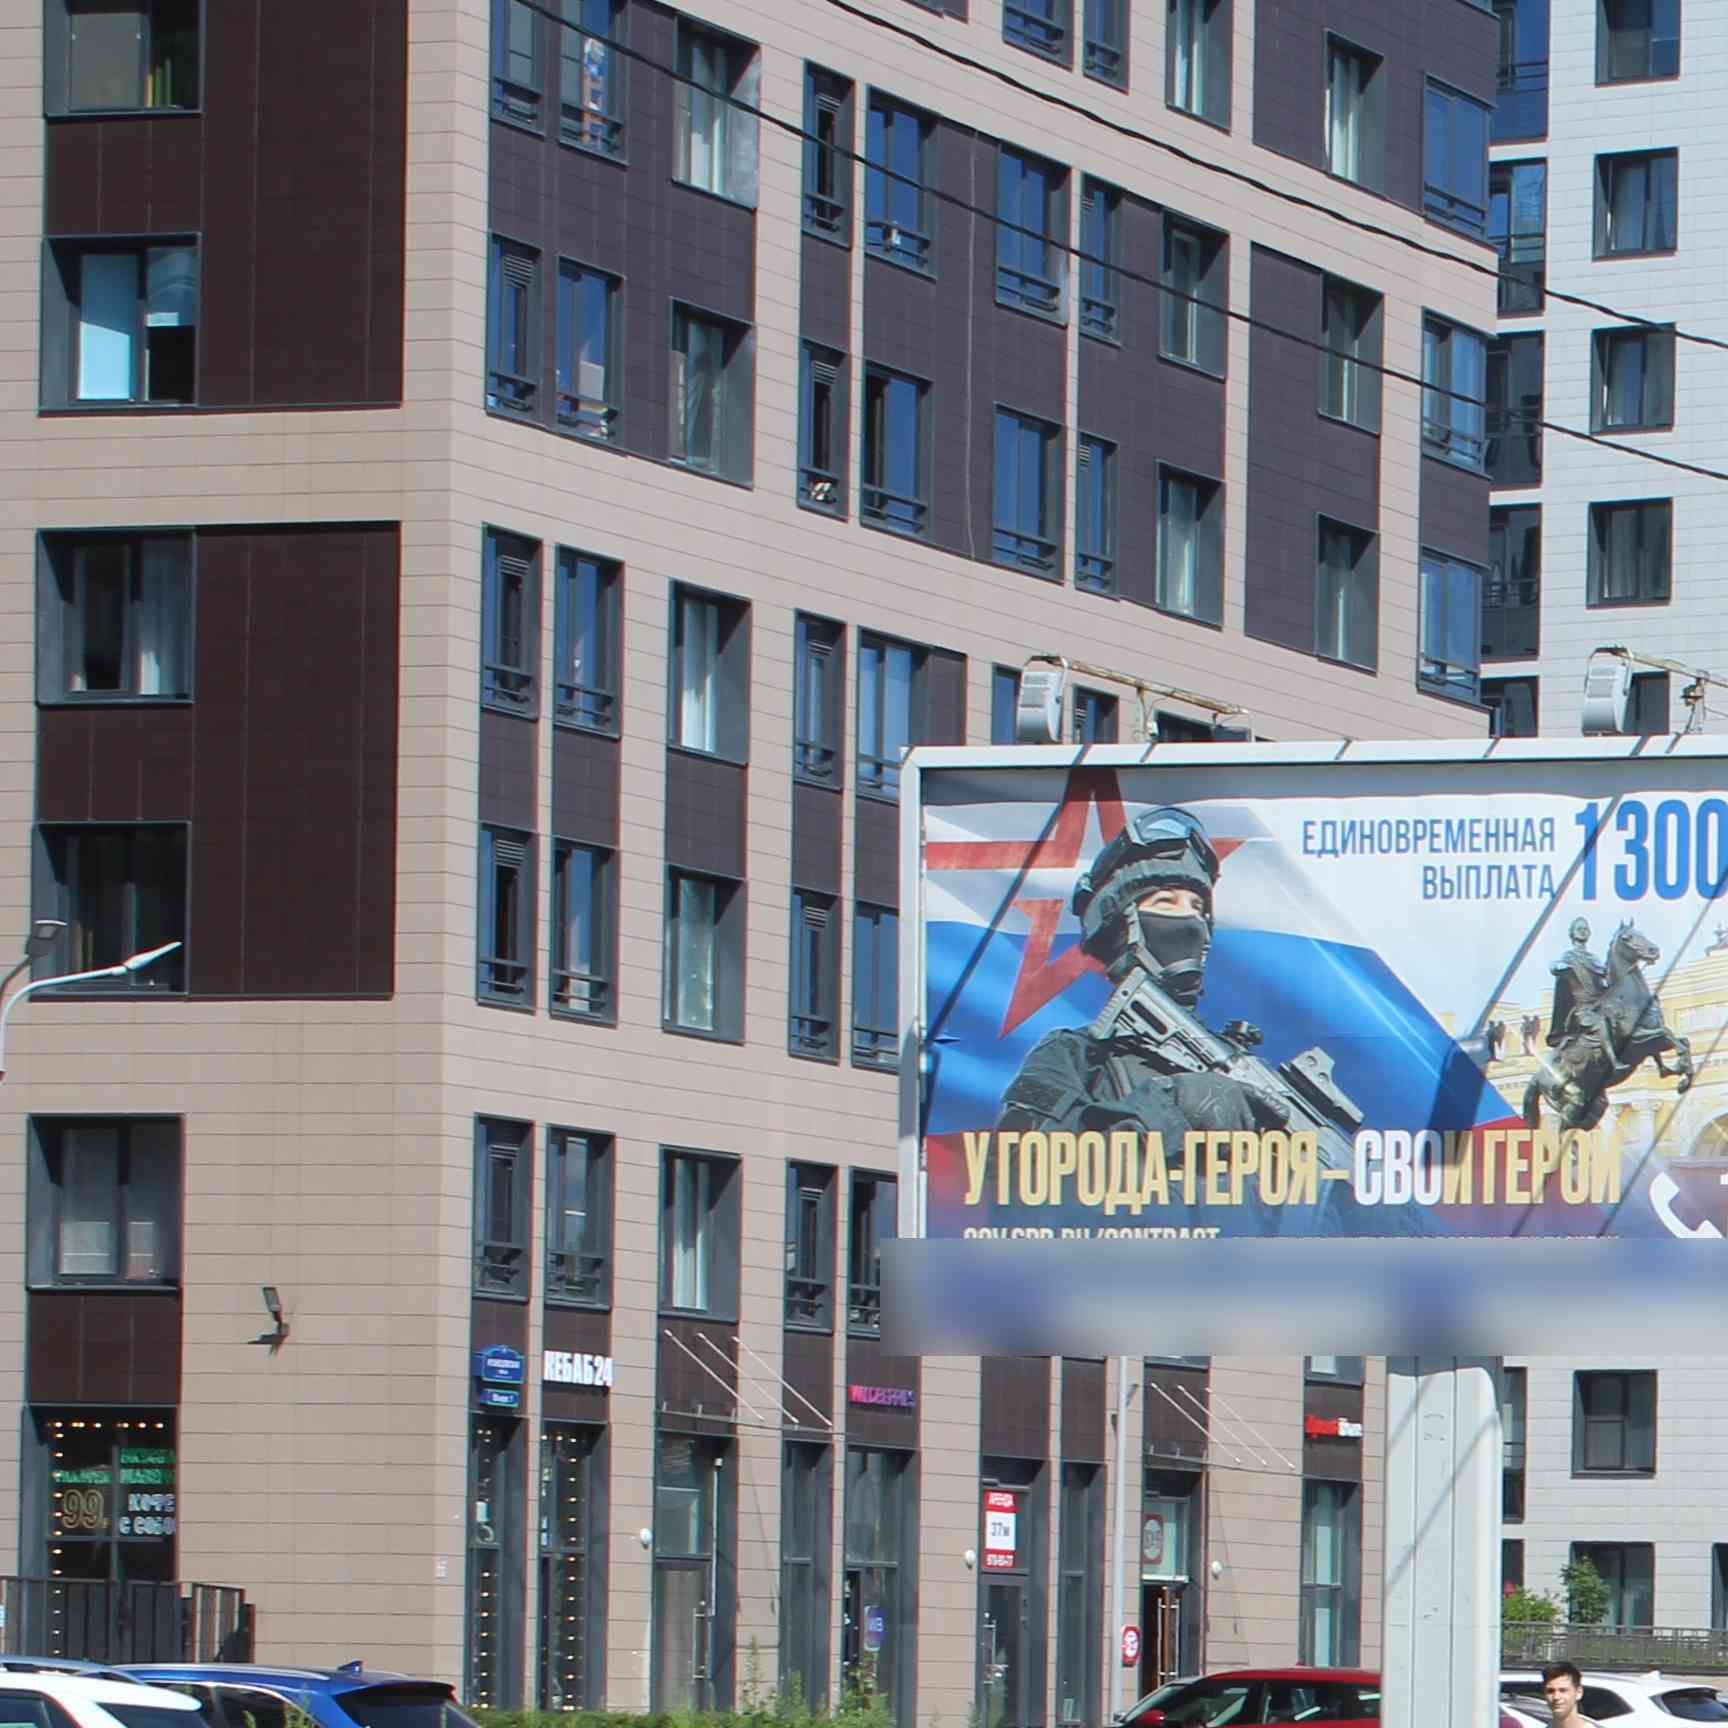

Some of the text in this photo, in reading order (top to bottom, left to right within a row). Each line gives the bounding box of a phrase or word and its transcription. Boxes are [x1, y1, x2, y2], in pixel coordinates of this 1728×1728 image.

[1303, 817, 1556, 859] ЕДИНОВРЕМЕННАЯ
[1423, 864, 1557, 901] ВЫПЛАТА
[962, 1131, 991, 1206] У
[1354, 1129, 1474, 1207] СВОИ
[1482, 1129, 1624, 1206] ГЕРОИ
